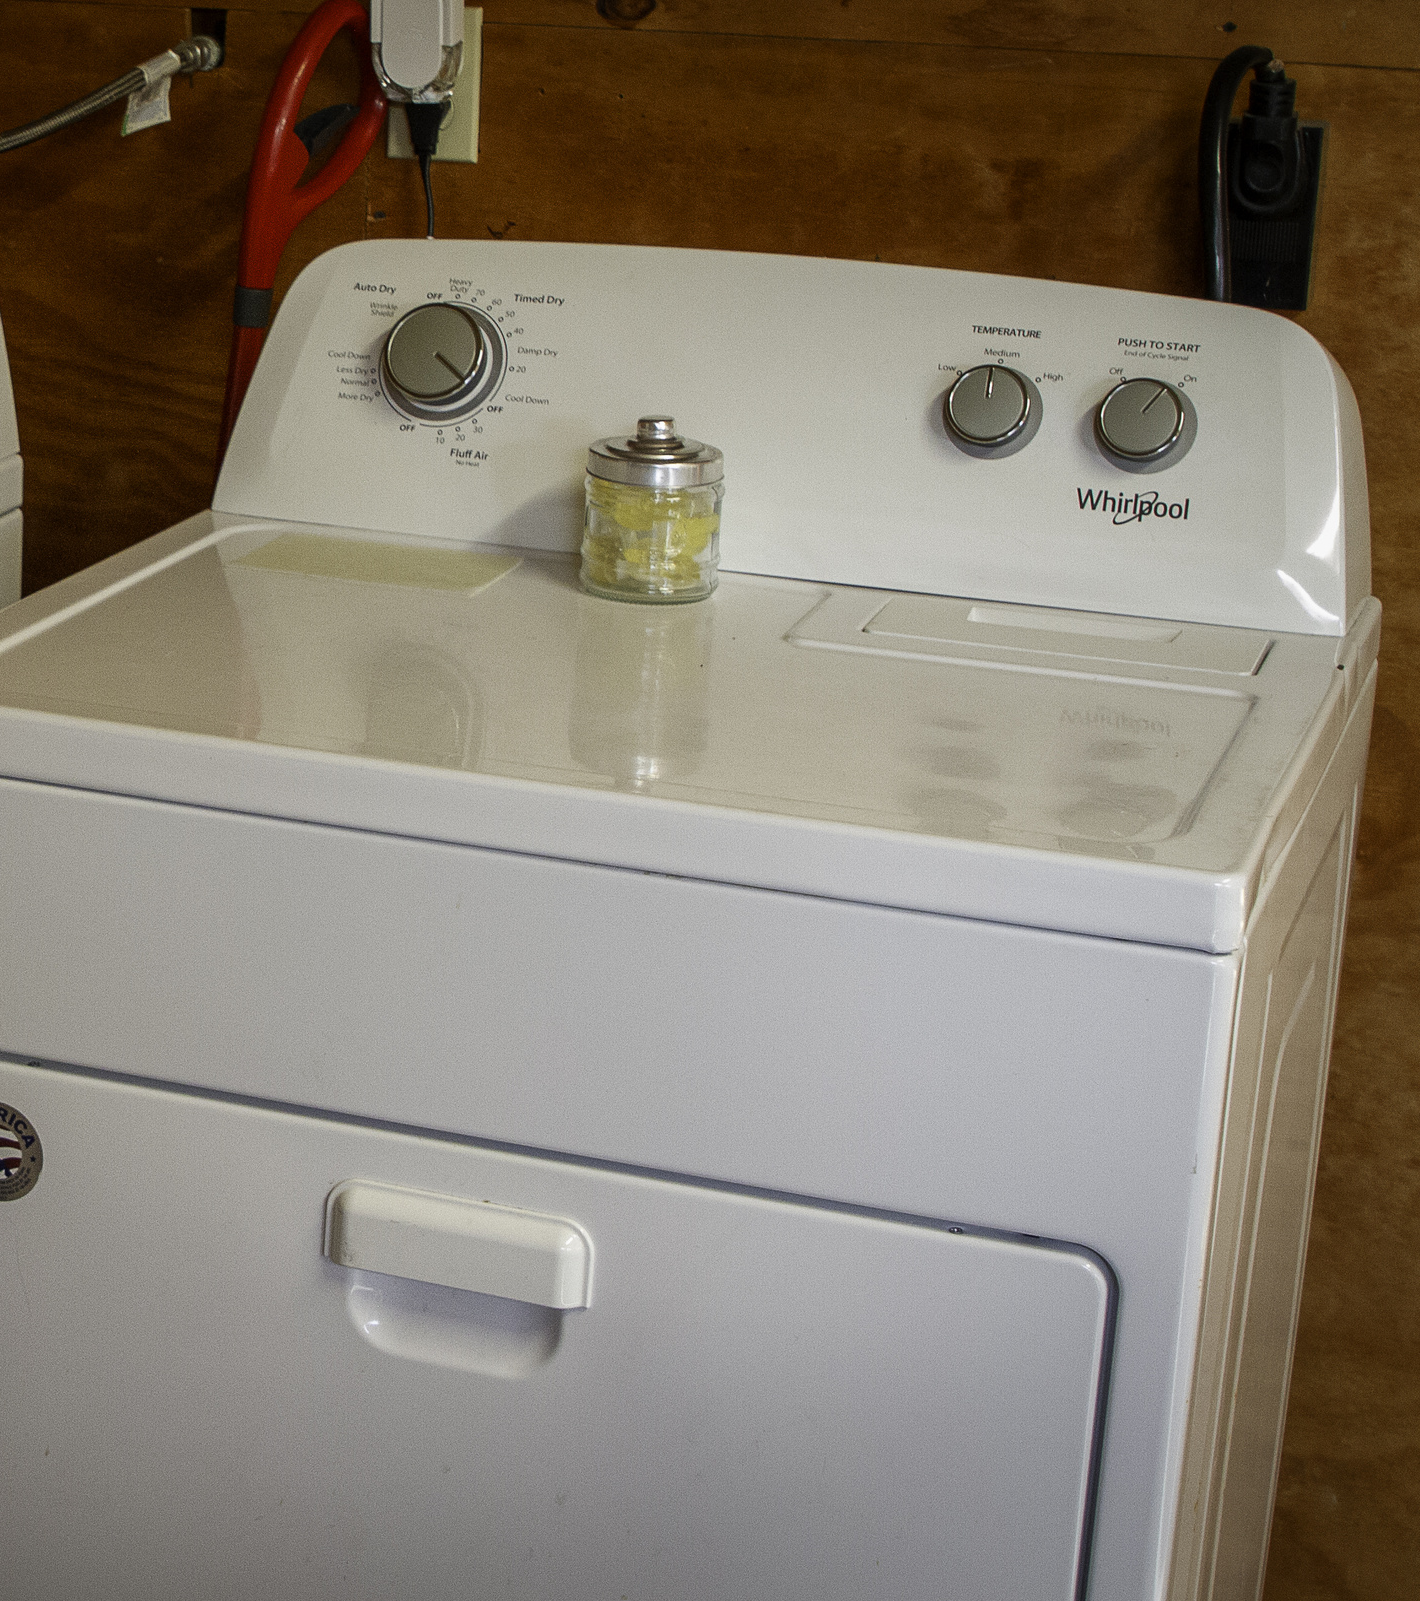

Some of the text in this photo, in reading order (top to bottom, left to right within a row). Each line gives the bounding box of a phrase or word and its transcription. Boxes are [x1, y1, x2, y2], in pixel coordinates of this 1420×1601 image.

[449, 278, 473, 287] Heavy
[353, 283, 397, 295] Auto Dry
[450, 286, 468, 294] Duty
[476, 289, 486, 297] 70
[492, 298, 502, 306] 60
[514, 294, 565, 306] Timed Dry
[505, 310, 516, 318] 50
[514, 327, 524, 335] 40
[972, 325, 1043, 339] TEMPERATURE
[1117, 338, 1201, 353] PUSH TO START
[327, 350, 371, 360] Cool Down
[517, 346, 559, 358] Damp Dry
[983, 348, 1021, 358] Medium
[1147, 351, 1167, 360] Cycle
[1167, 353, 1189, 362] Signal
[354, 366, 368, 376] Dry
[516, 365, 526, 373] 20
[938, 363, 957, 371] Low
[1109, 367, 1124, 375] Off
[340, 377, 370, 387] Normal
[1043, 372, 1064, 383] High
[1183, 374, 1197, 383] On
[338, 392, 373, 403] More Dry
[504, 393, 549, 405] Cool Down
[487, 405, 504, 413] OFF
[399, 424, 416, 432] OFF
[473, 426, 483, 434] 30
[455, 434, 466, 442] 20
[450, 447, 489, 461] Fluff Air
[1077, 487, 1191, 525] Whirlpool
